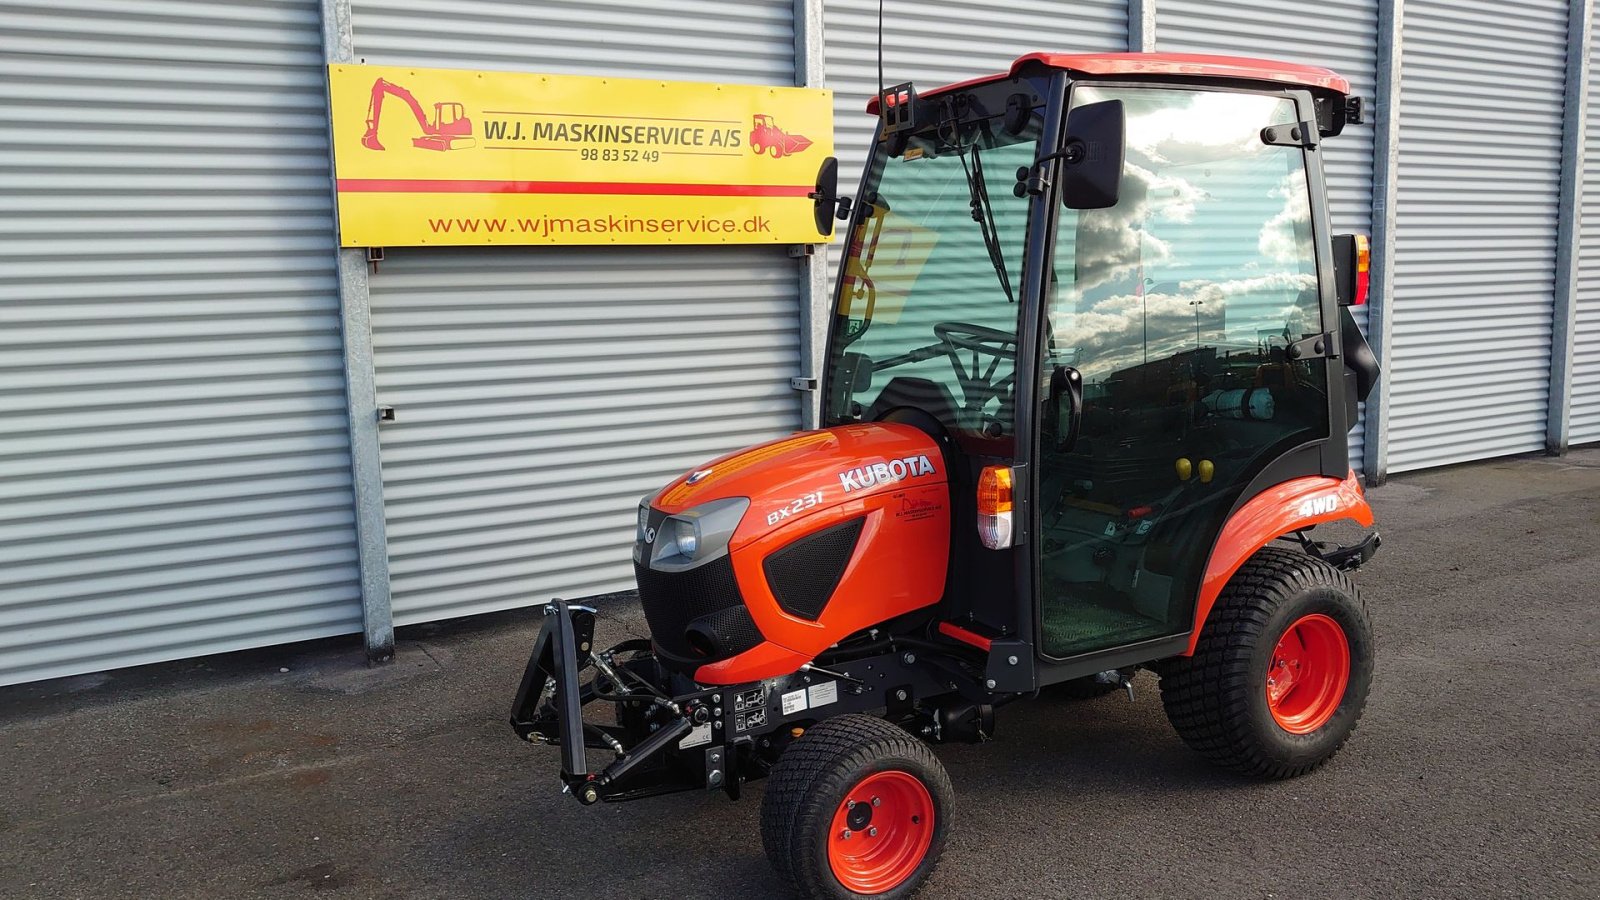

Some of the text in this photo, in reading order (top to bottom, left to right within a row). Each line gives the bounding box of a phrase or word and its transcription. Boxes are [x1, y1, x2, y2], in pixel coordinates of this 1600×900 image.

[484, 120, 742, 148] W.J. MASKINSERVICE A/S
[581, 148, 659, 163] 98 83 52 49
[428, 214, 771, 237] www.wjmaskinservice.dk
[838, 455, 936, 493] KUBOTA
[767, 491, 823, 525] BX231
[1298, 494, 1337, 517] 4WD
